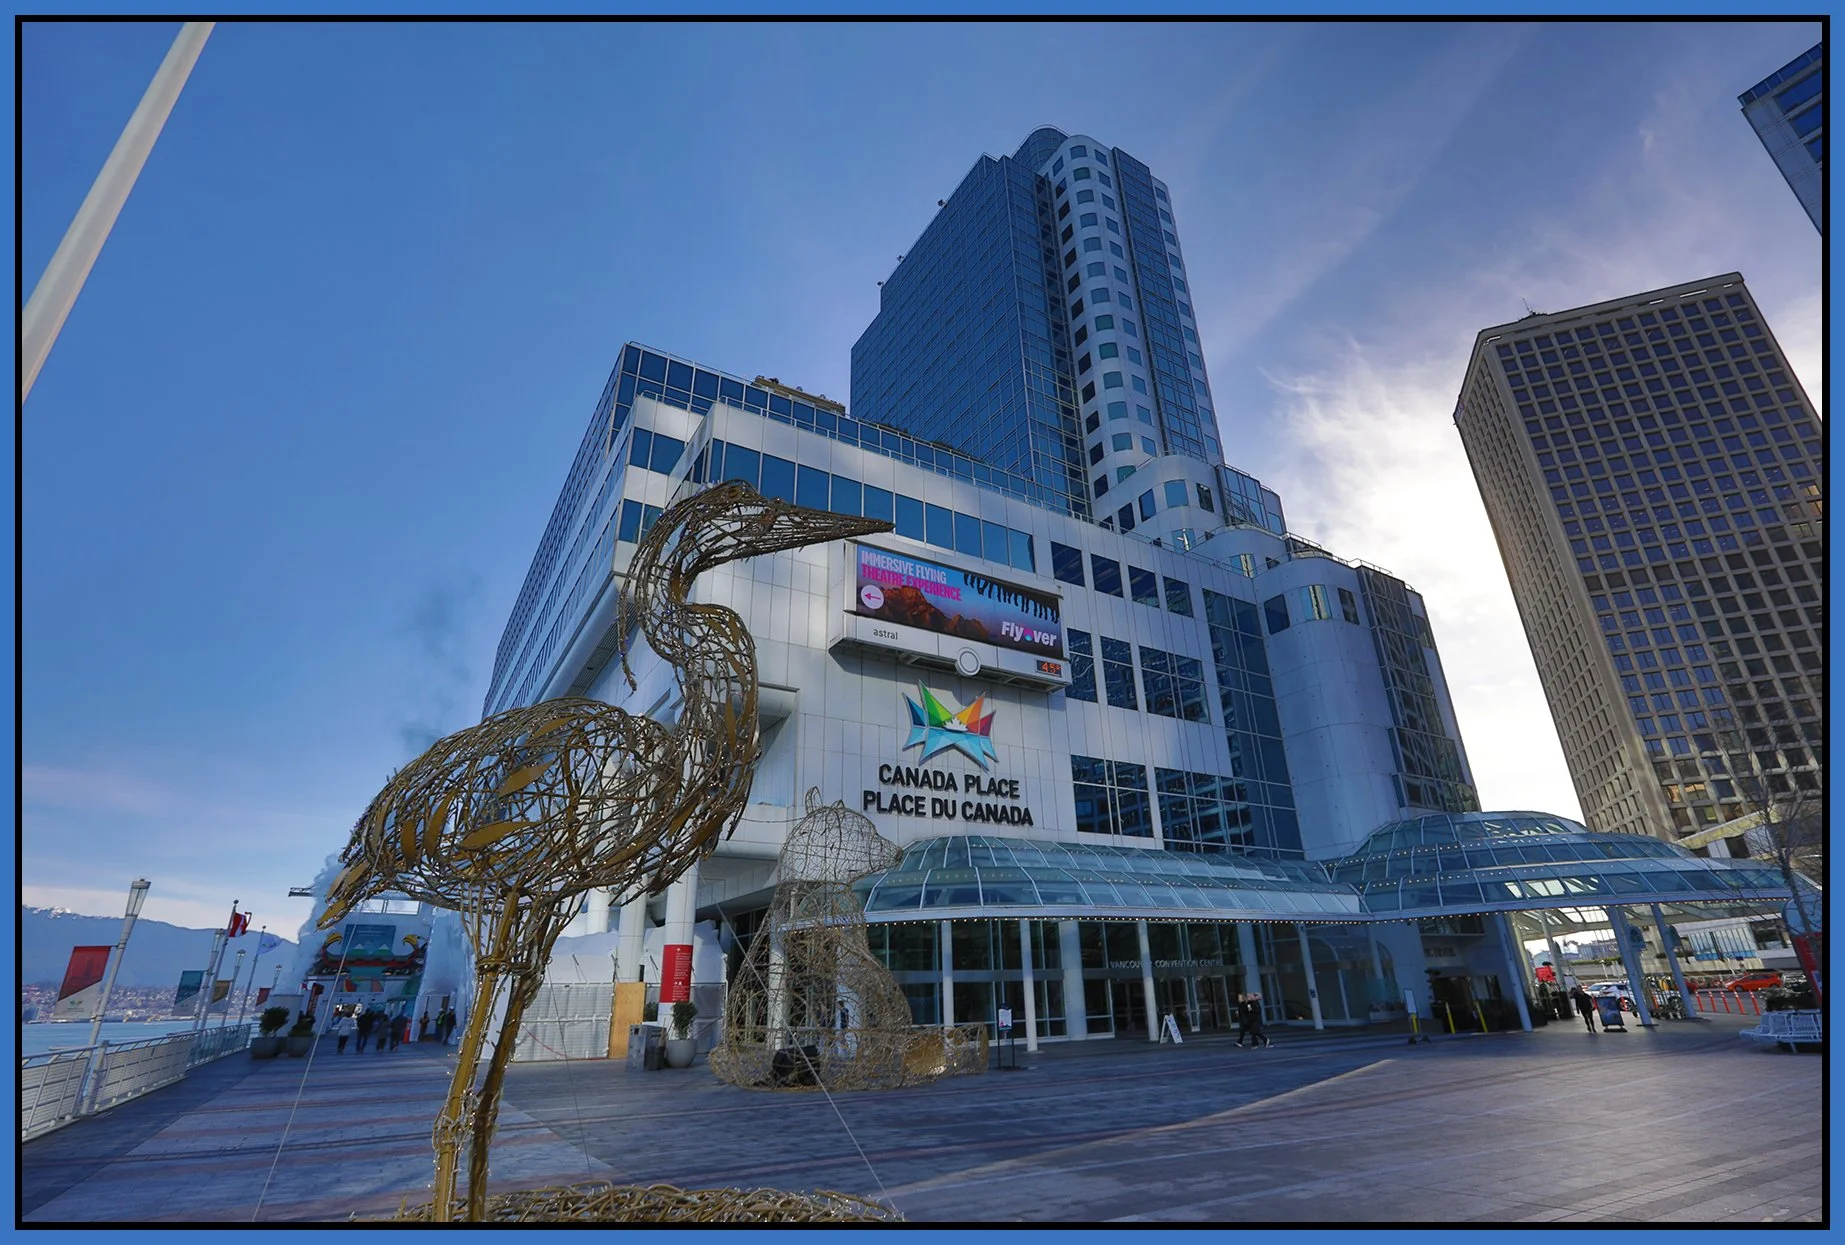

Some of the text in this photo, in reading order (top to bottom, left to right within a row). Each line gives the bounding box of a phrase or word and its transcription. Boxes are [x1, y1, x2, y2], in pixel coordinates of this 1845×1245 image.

[861, 551, 947, 585] IMMERSIVE FLYING
[861, 564, 961, 602] THEATRE EXPERIENCE
[873, 628, 898, 640] astral
[879, 763, 1020, 799] CANADA PLACE
[863, 790, 1033, 826] PLACE DU CANADA
[1155, 959, 1198, 968] CONVENTION
